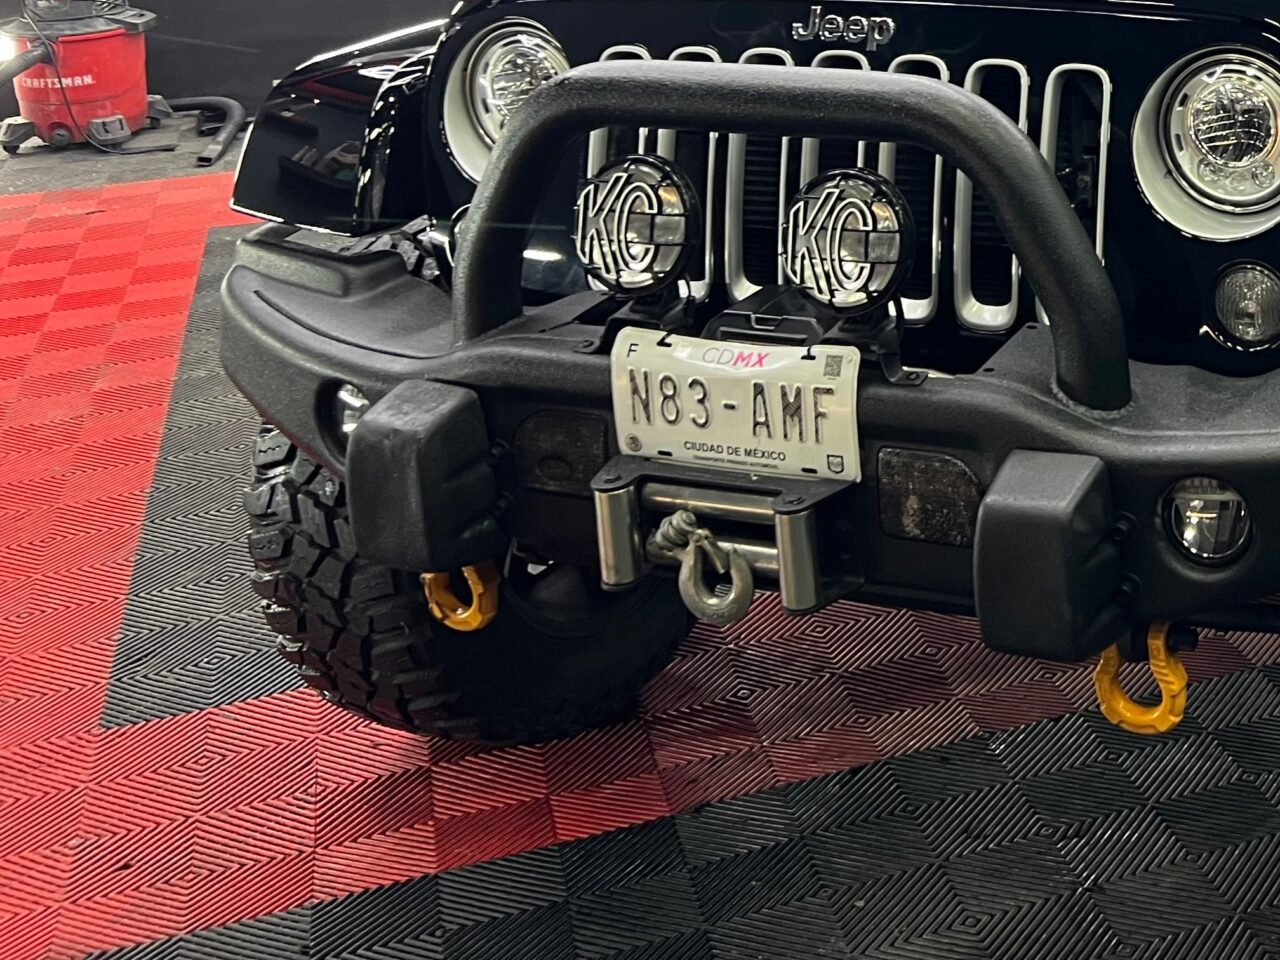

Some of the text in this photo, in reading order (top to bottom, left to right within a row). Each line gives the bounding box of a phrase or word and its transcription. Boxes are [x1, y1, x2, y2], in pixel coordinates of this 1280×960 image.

[791, 5, 896, 52] Jeep
[20, 74, 93, 89] CRAFTSMAN
[576, 172, 658, 283] KC
[786, 188, 873, 301] KC
[626, 343, 640, 359] F
[702, 347, 771, 369] CDMX
[628, 368, 836, 444] N83-AMF
[683, 440, 724, 455] CIUDAD
[726, 445, 742, 457] DE
[743, 447, 787, 462] MÉXICO
